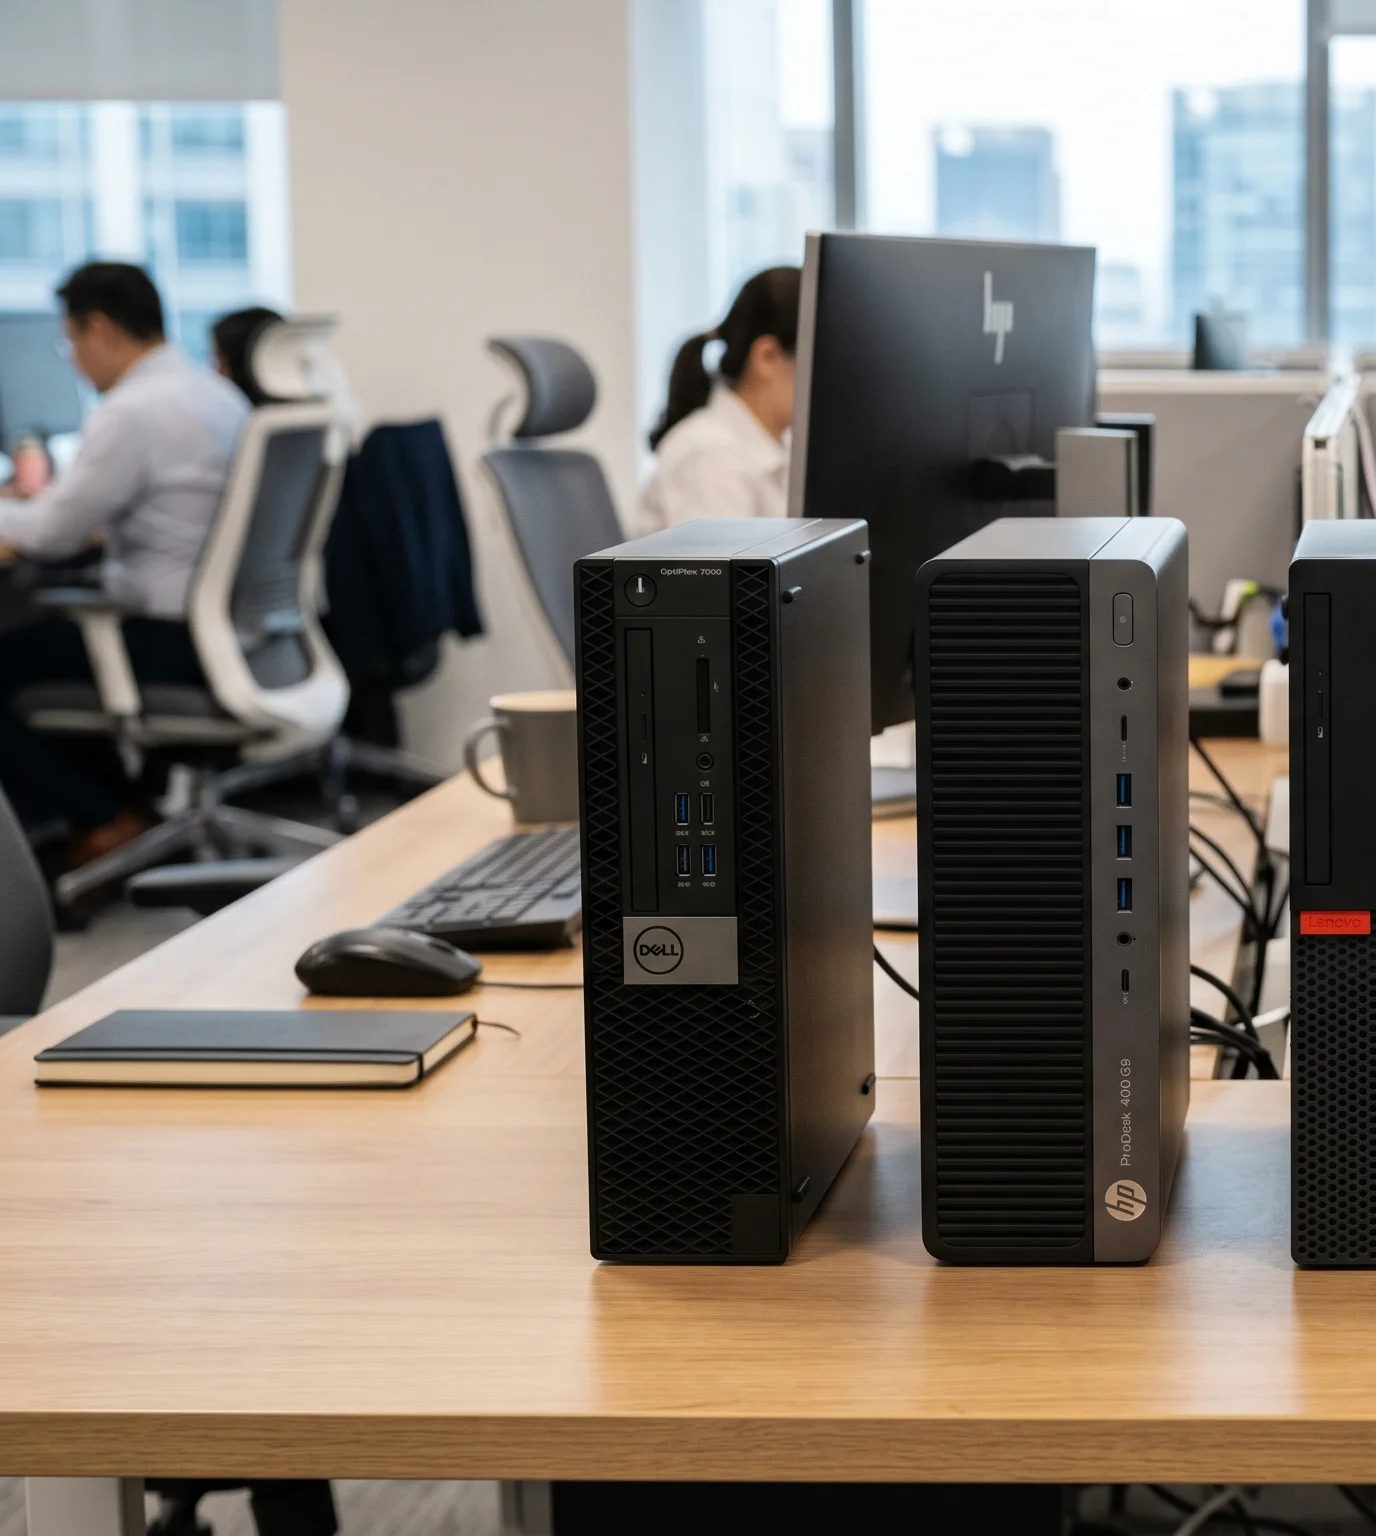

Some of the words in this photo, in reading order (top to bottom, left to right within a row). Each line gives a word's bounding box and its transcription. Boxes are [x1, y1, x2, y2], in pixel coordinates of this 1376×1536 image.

[700, 568, 722, 576] 7000
[1308, 915, 1361, 928] Lenovo
[639, 944, 679, 957] DELL
[1120, 1058, 1131, 1077] G9
[1120, 1079, 1131, 1107] 400
[1120, 1111, 1132, 1167] ProDesk
[1105, 1180, 1147, 1221] hp
